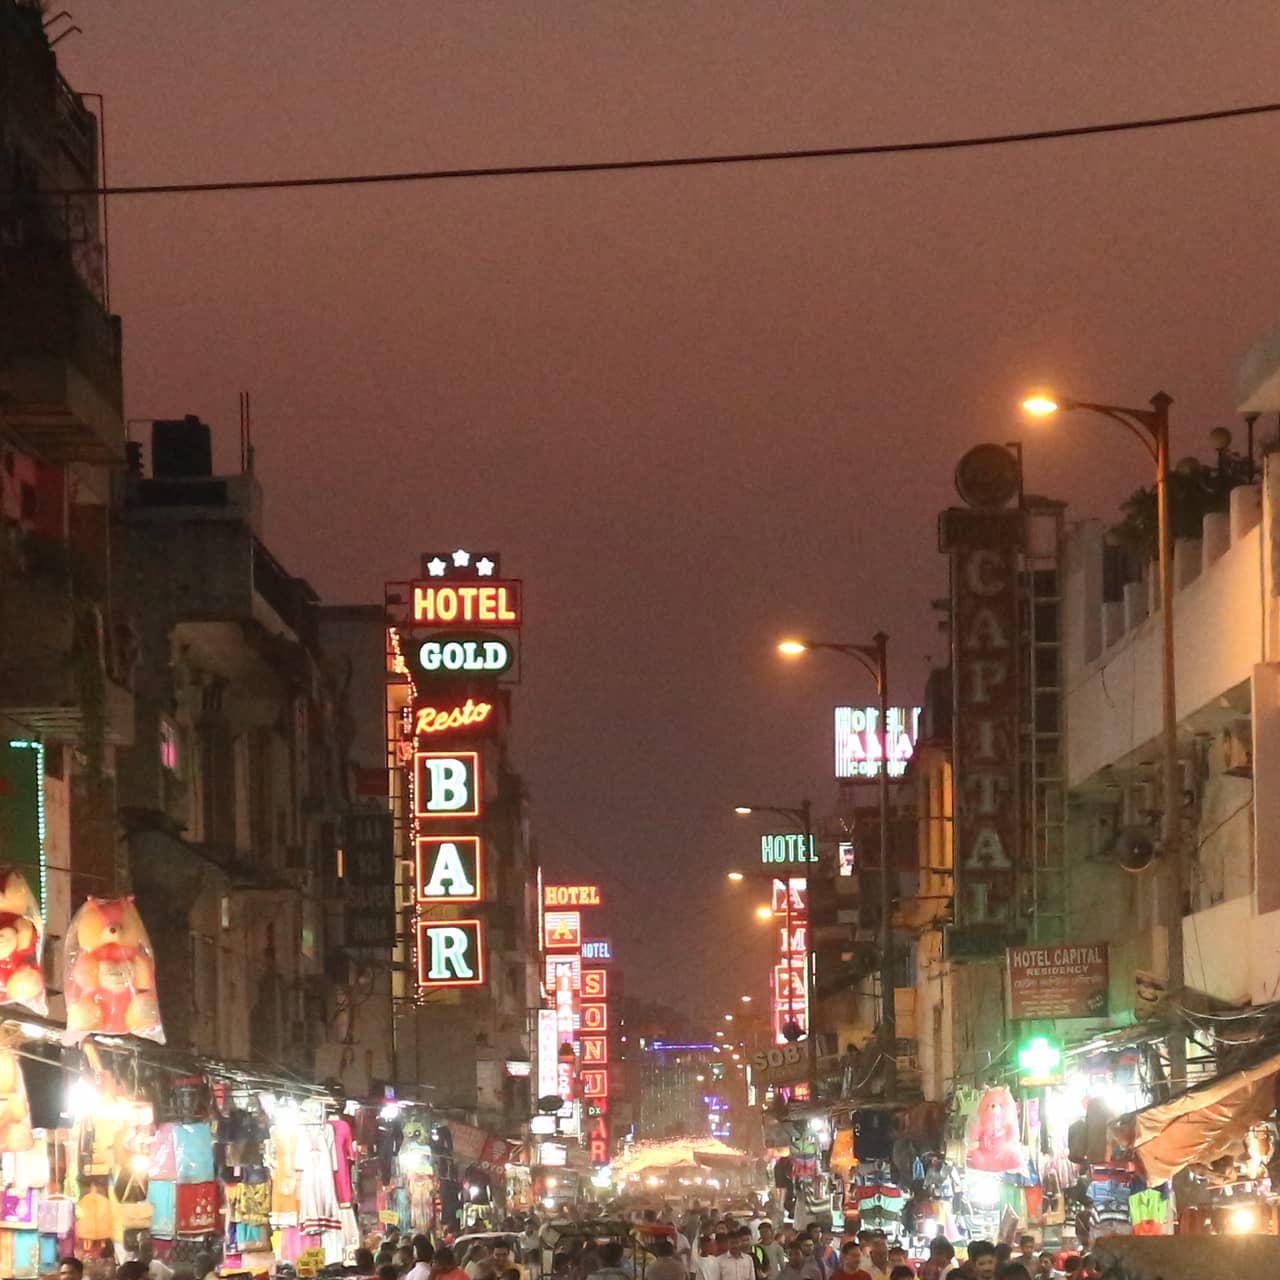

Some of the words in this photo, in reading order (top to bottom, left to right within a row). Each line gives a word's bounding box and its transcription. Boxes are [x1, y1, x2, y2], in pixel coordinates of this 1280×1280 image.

[414, 587, 516, 621] HOTEL
[419, 641, 508, 671] GOLD
[415, 698, 492, 734] Resto
[966, 552, 1012, 921] CAPITAL
[761, 833, 820, 864] HOTEL
[422, 757, 476, 980] BAR
[544, 885, 600, 906] HOTEL
[1013, 949, 1051, 968] HOTEL
[1054, 946, 1102, 966] CAPITAL
[1026, 965, 1089, 977] RESIDENCY
[584, 973, 602, 1093] SONU
